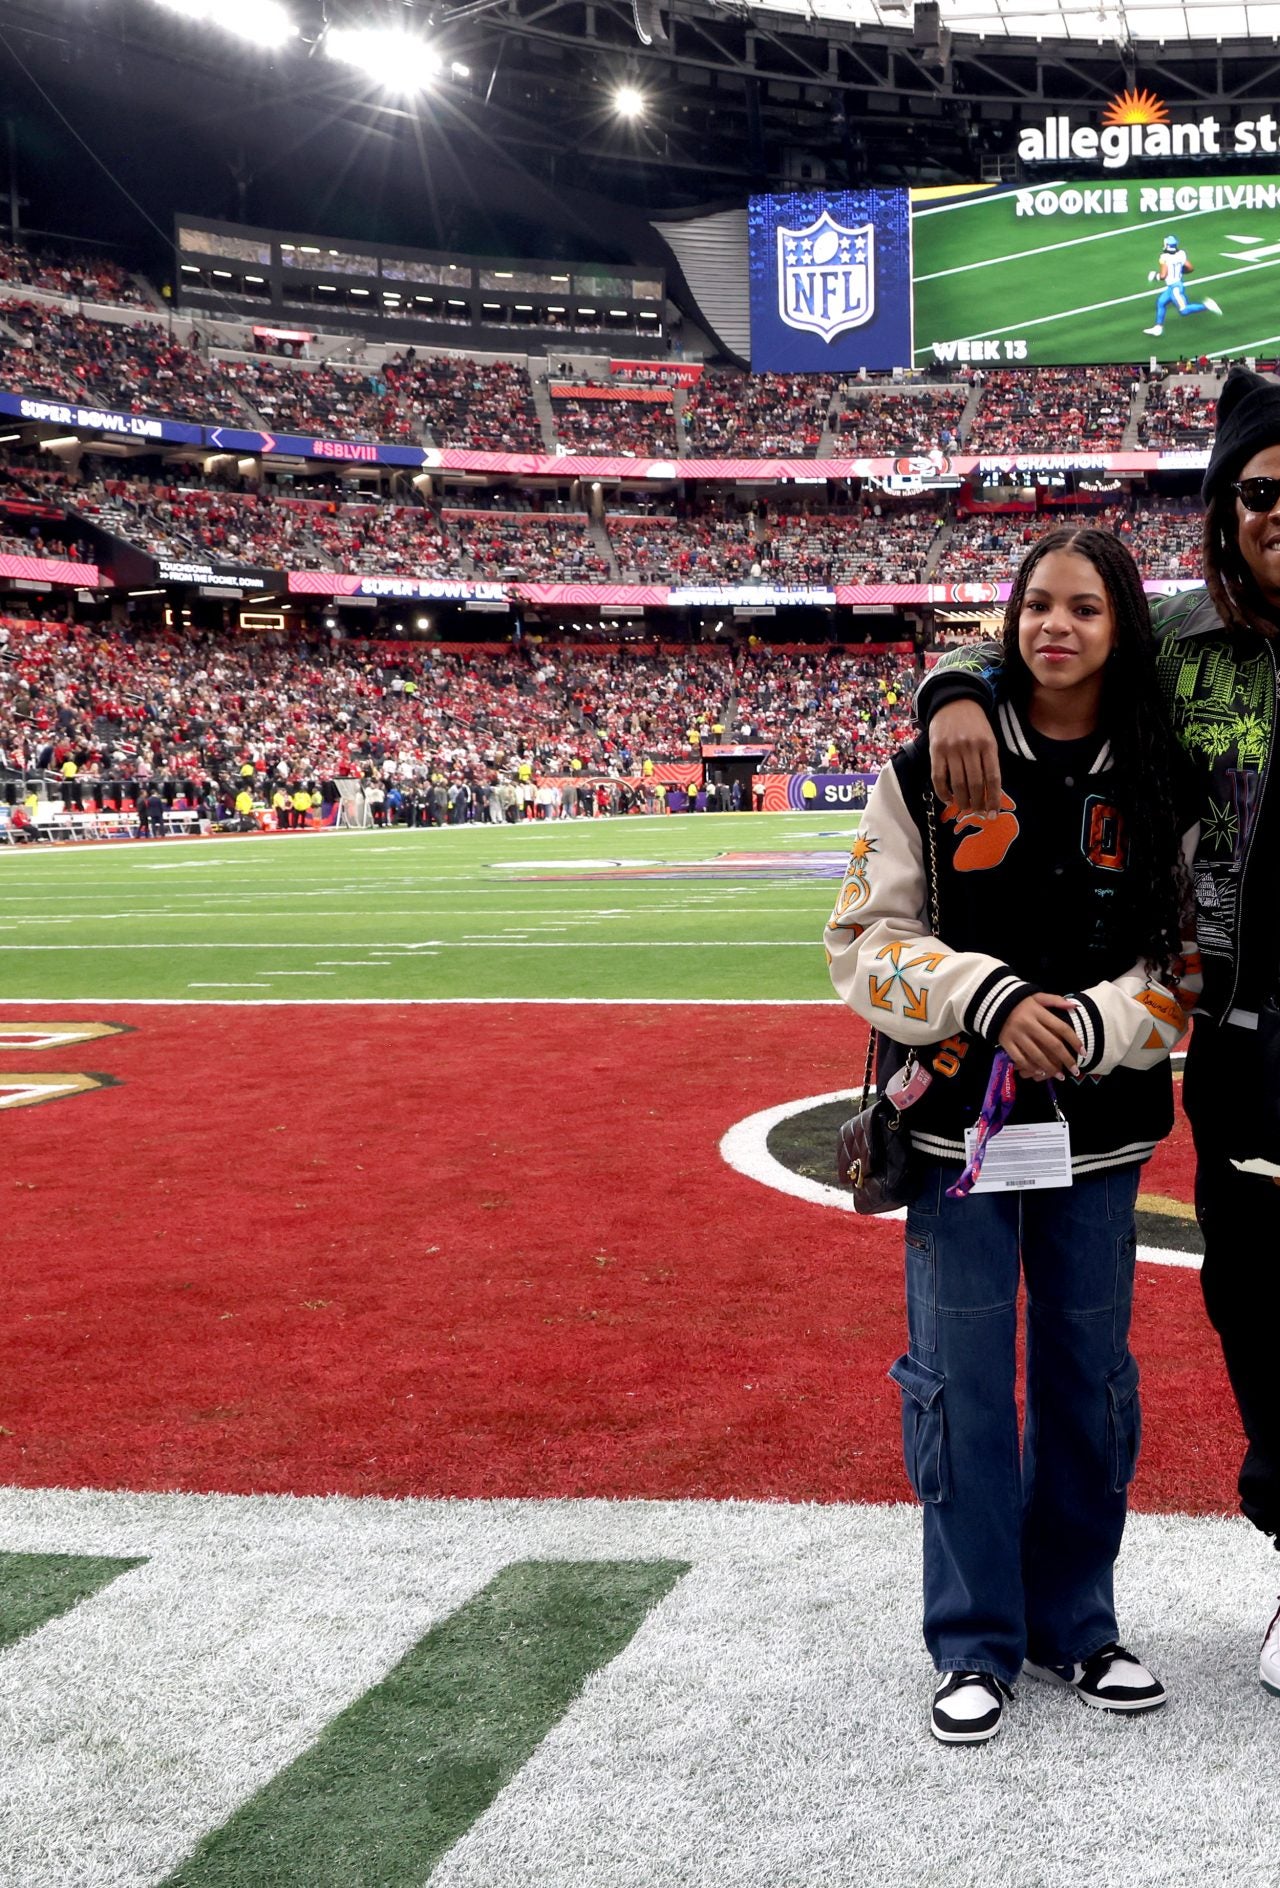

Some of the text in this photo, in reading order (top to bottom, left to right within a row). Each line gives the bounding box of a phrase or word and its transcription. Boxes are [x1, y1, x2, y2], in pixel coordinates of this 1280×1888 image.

[1017, 115, 1220, 168] allegiant
[1016, 188, 1128, 217] ROOKIE
[792, 271, 860, 320] NFL
[932, 340, 1028, 361] WEEK 13
[313, 440, 378, 460] #SBLVIII
[980, 455, 1112, 471] NFC CHAMPIONS
